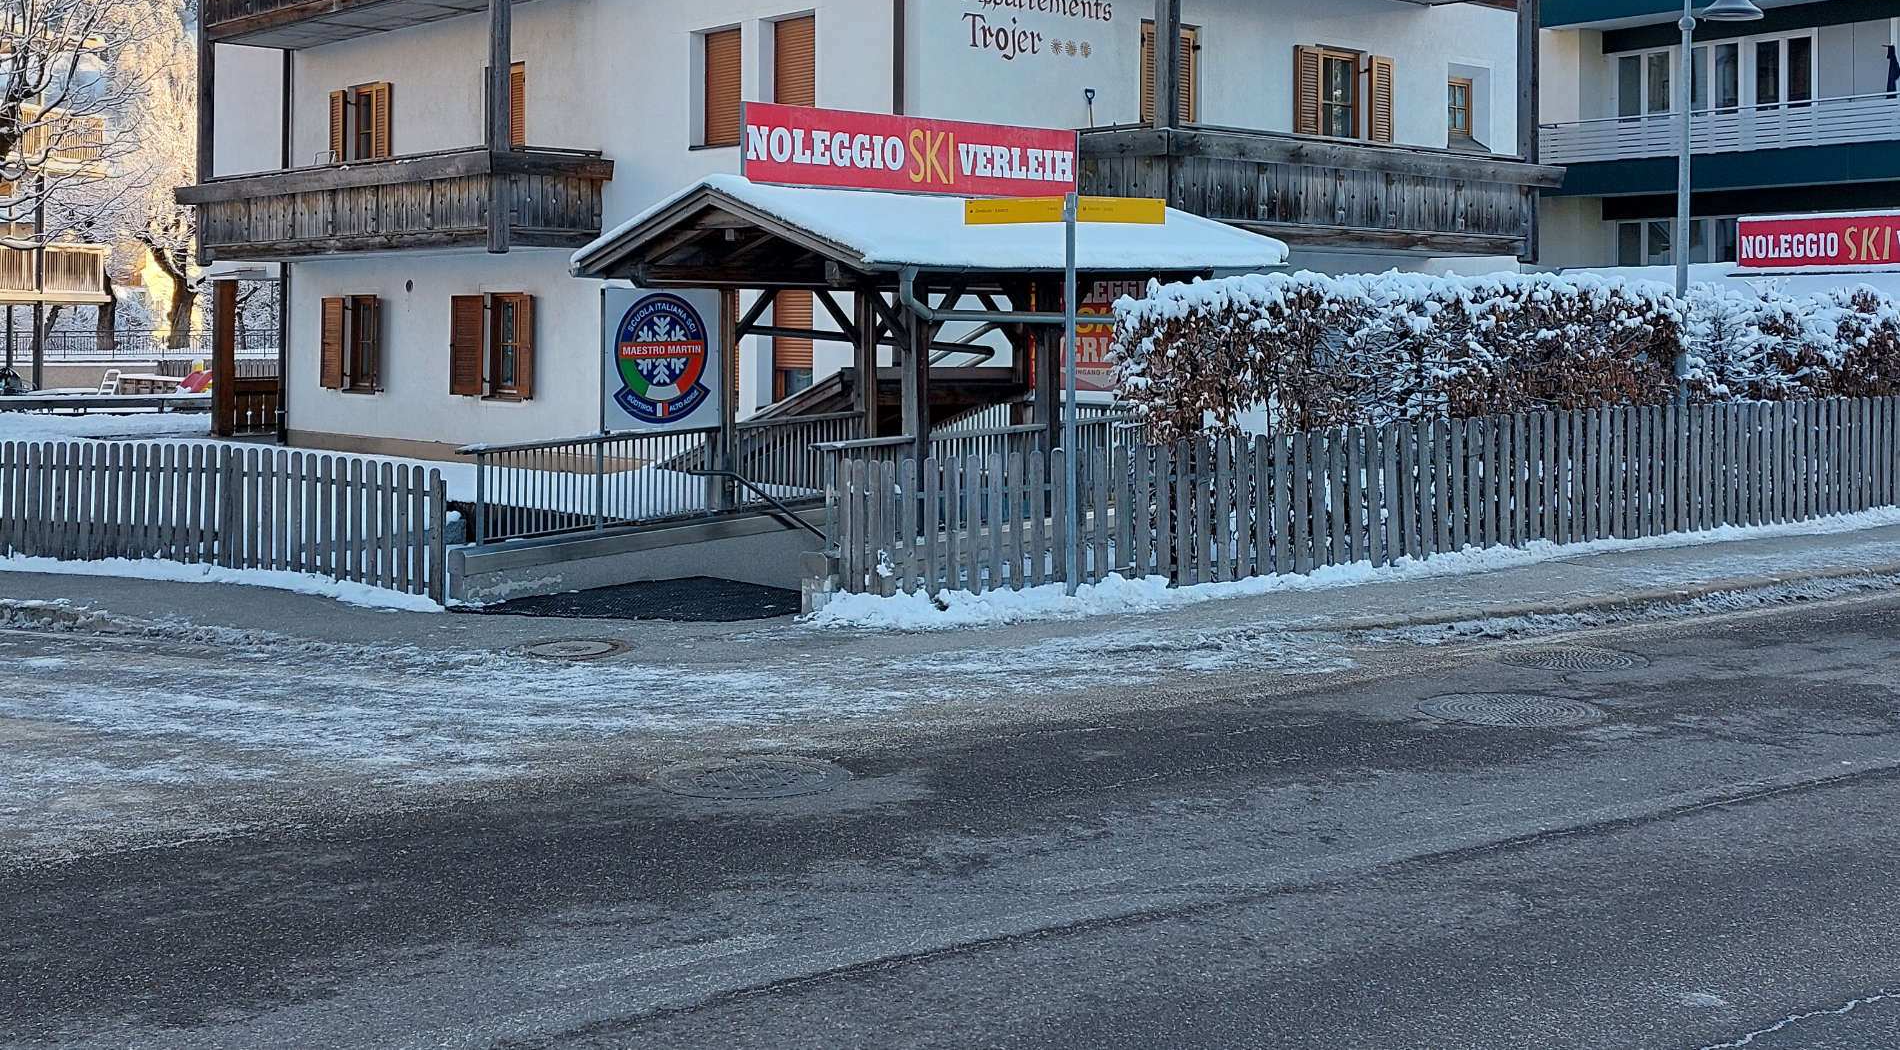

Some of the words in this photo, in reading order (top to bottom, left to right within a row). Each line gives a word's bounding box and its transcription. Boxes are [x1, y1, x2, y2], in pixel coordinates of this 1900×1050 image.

[961, 12, 1043, 60] Trojer
[746, 124, 905, 171] NOLEGGIO
[908, 128, 955, 185] SKI
[958, 143, 1074, 183] VERLEIH
[1741, 232, 1839, 259] NOLEGGIO
[1844, 226, 1892, 261] SKI
[627, 304, 655, 332] SCUOLA
[655, 302, 688, 320] ITALIANA
[686, 317, 697, 333] SCI
[622, 345, 665, 355] MAESTRO
[667, 344, 701, 354] MARTIN
[669, 401, 684, 412] ALTO
